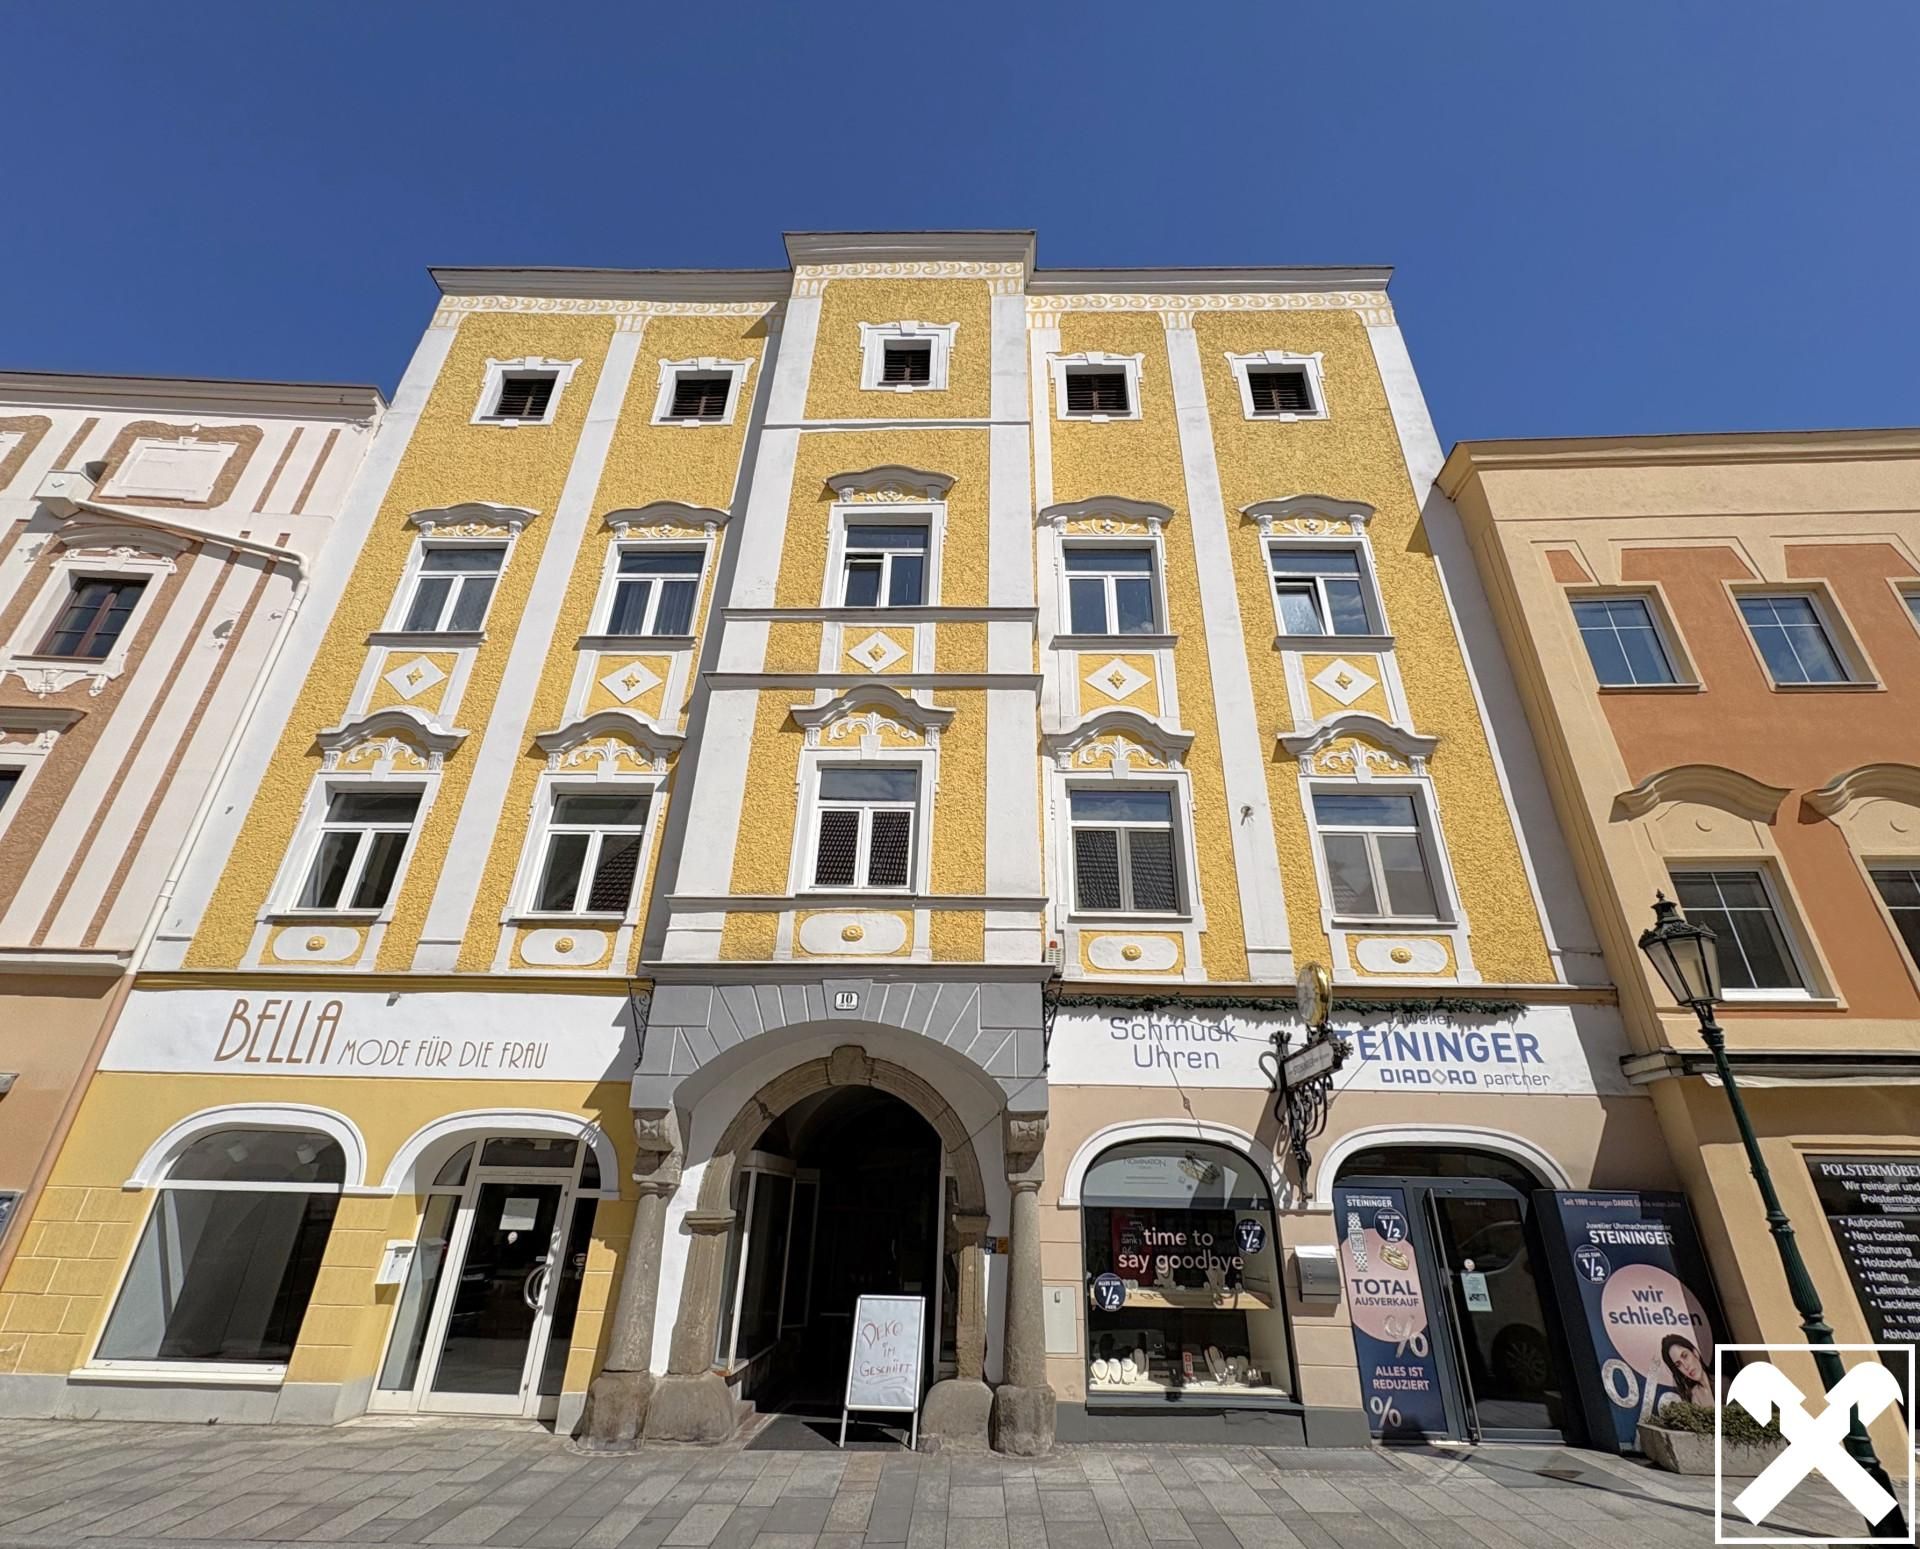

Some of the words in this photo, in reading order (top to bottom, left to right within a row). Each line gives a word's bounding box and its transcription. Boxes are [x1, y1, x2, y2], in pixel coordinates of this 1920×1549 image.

[841, 993, 853, 1004] 10
[213, 998, 344, 1065] BELLA
[336, 1038, 411, 1066] MODE
[414, 1035, 453, 1068] FÜR
[458, 1040, 494, 1068] DIE
[498, 1041, 549, 1069] FRAU
[1110, 1016, 1239, 1042] Schmuck
[1332, 1029, 1545, 1064] TEININGER
[1133, 1043, 1220, 1070] Uhren
[1483, 1072, 1551, 1089] partner
[1842, 1180, 1860, 1191] Wir
[1861, 1181, 1901, 1193] reinigen
[1346, 1198, 1393, 1209] STEININGER
[1847, 1218, 1905, 1229] Aufpolstern
[1143, 1226, 1188, 1246] time
[1192, 1229, 1214, 1247] to
[1589, 1230, 1675, 1246] STEININGER
[1851, 1231, 1873, 1241] Neu
[1873, 1231, 1920, 1242] beziehen
[1118, 1253, 1150, 1274] say
[1156, 1248, 1244, 1275] goodbye
[1861, 1257, 1920, 1268] Holzoberflä
[1867, 1271, 1910, 1284] Haftung
[1351, 1278, 1418, 1296] TOTAL
[1631, 1285, 1664, 1303] wir
[1354, 1297, 1420, 1308] AUSVERKAUF
[1608, 1306, 1703, 1327] schließen
[1375, 1366, 1407, 1377] ALLES
[1408, 1367, 1424, 1378] IST
[1372, 1379, 1430, 1391] REDUZIERT
